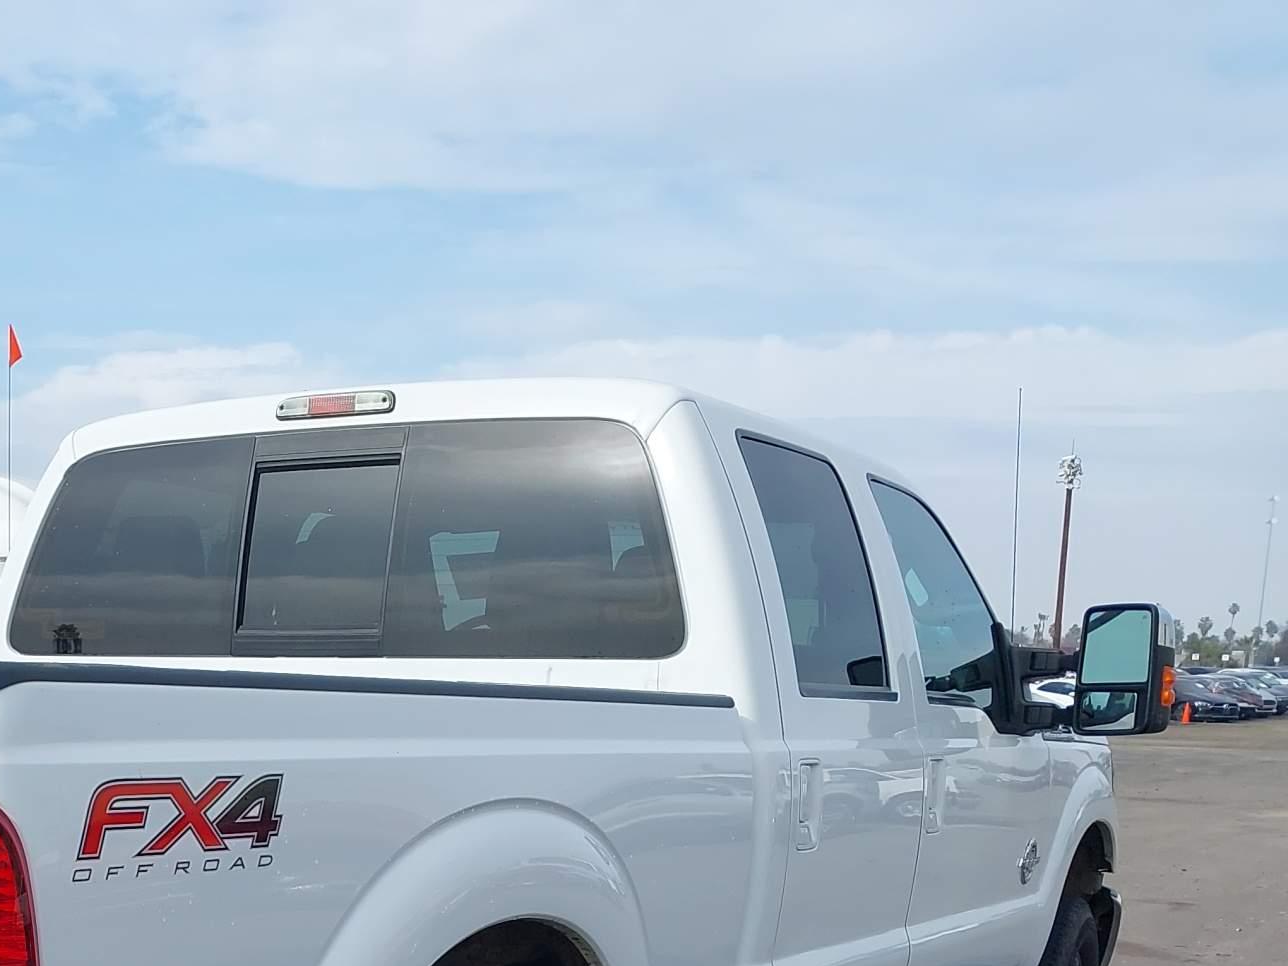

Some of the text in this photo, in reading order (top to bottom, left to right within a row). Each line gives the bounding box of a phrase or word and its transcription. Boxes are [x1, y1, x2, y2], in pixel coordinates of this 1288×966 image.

[75, 773, 284, 862] FX4
[71, 854, 274, 883] OFF ROAD
